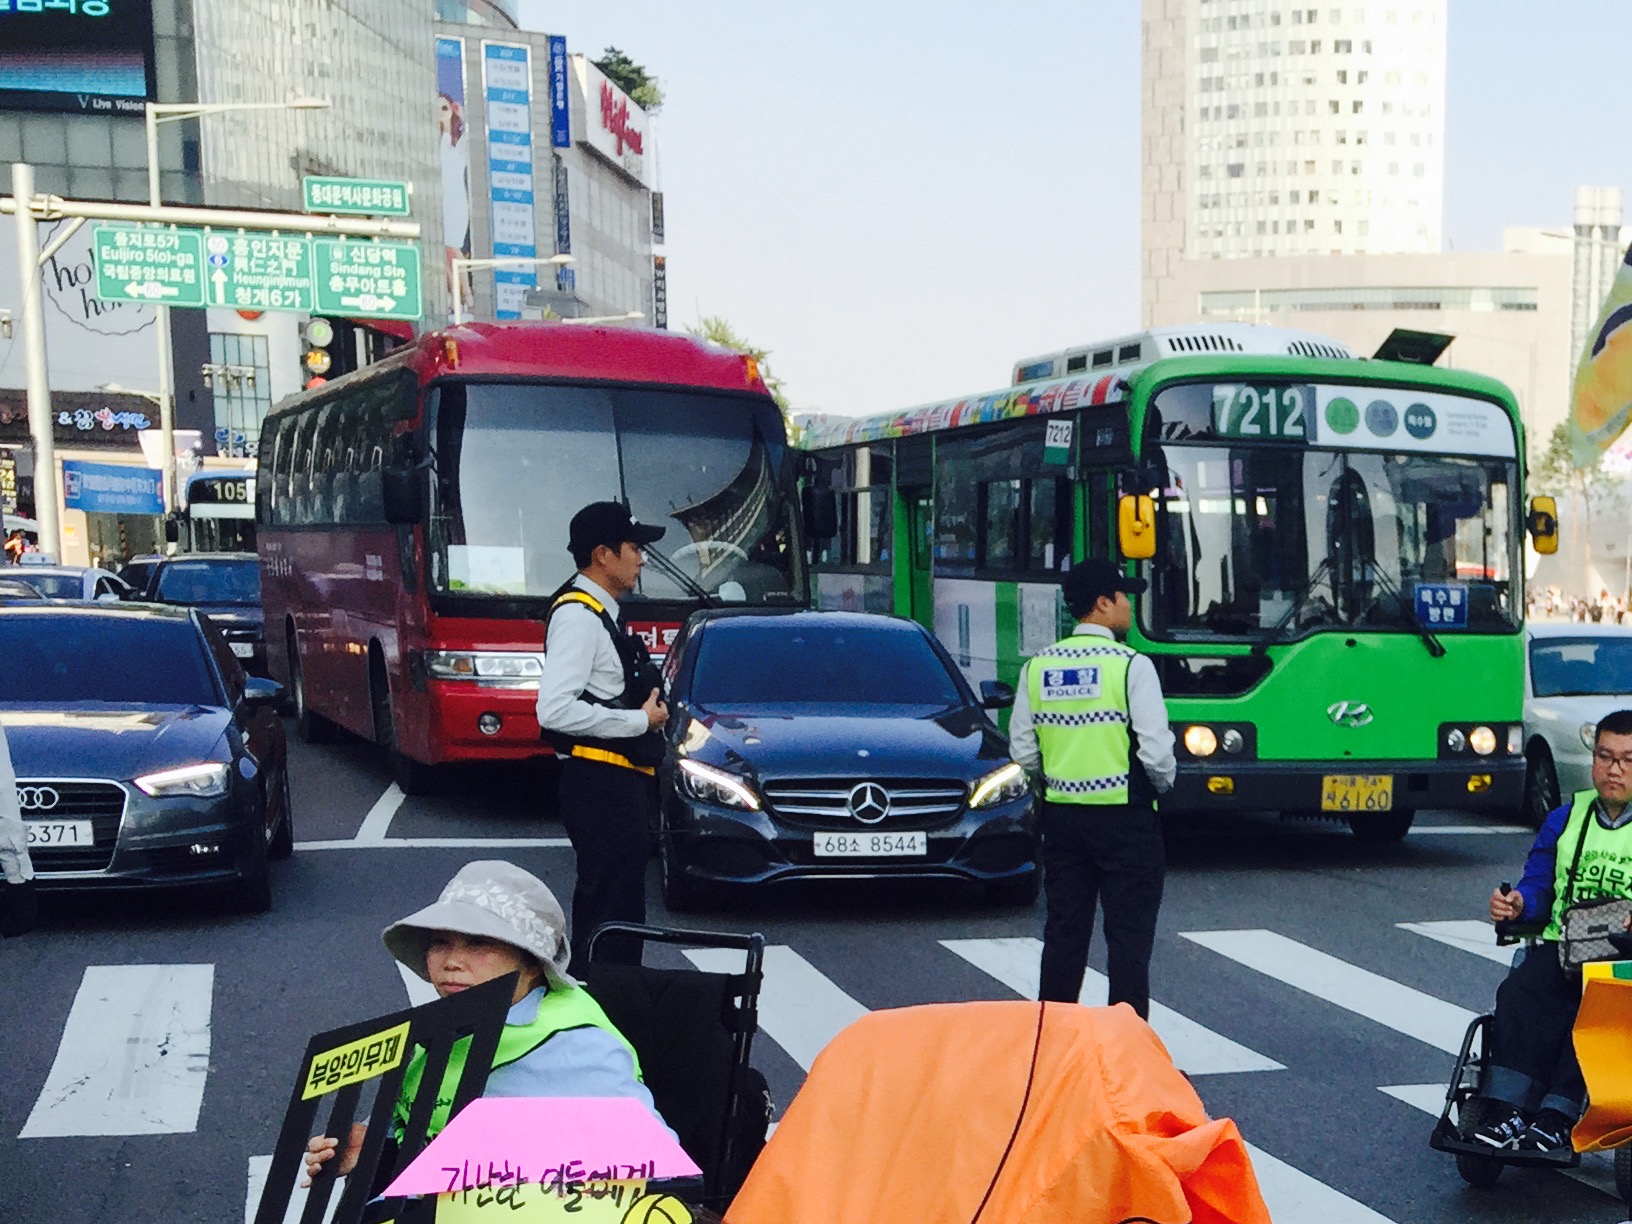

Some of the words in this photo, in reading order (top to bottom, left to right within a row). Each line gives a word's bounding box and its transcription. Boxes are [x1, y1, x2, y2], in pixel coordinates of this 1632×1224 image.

[114, 231, 180, 249] 을지로5가
[232, 238, 303, 260] 흥인지문
[350, 246, 397, 265] 신당역
[103, 264, 196, 284] 국립중앙의료원
[330, 261, 381, 278] Sindang
[383, 265, 406, 279] Stn
[235, 287, 302, 308] 청계6가
[1212, 384, 1305, 436] 7212
[1047, 424, 1071, 443] 7212
[214, 481, 247, 500] 105
[1047, 687, 1093, 697] POLICE
[1341, 789, 1389, 811] 6160
[871, 836, 917, 852] 8544
[309, 1033, 402, 1090] 부양의무제
[441, 1159, 528, 1211] 가난한
